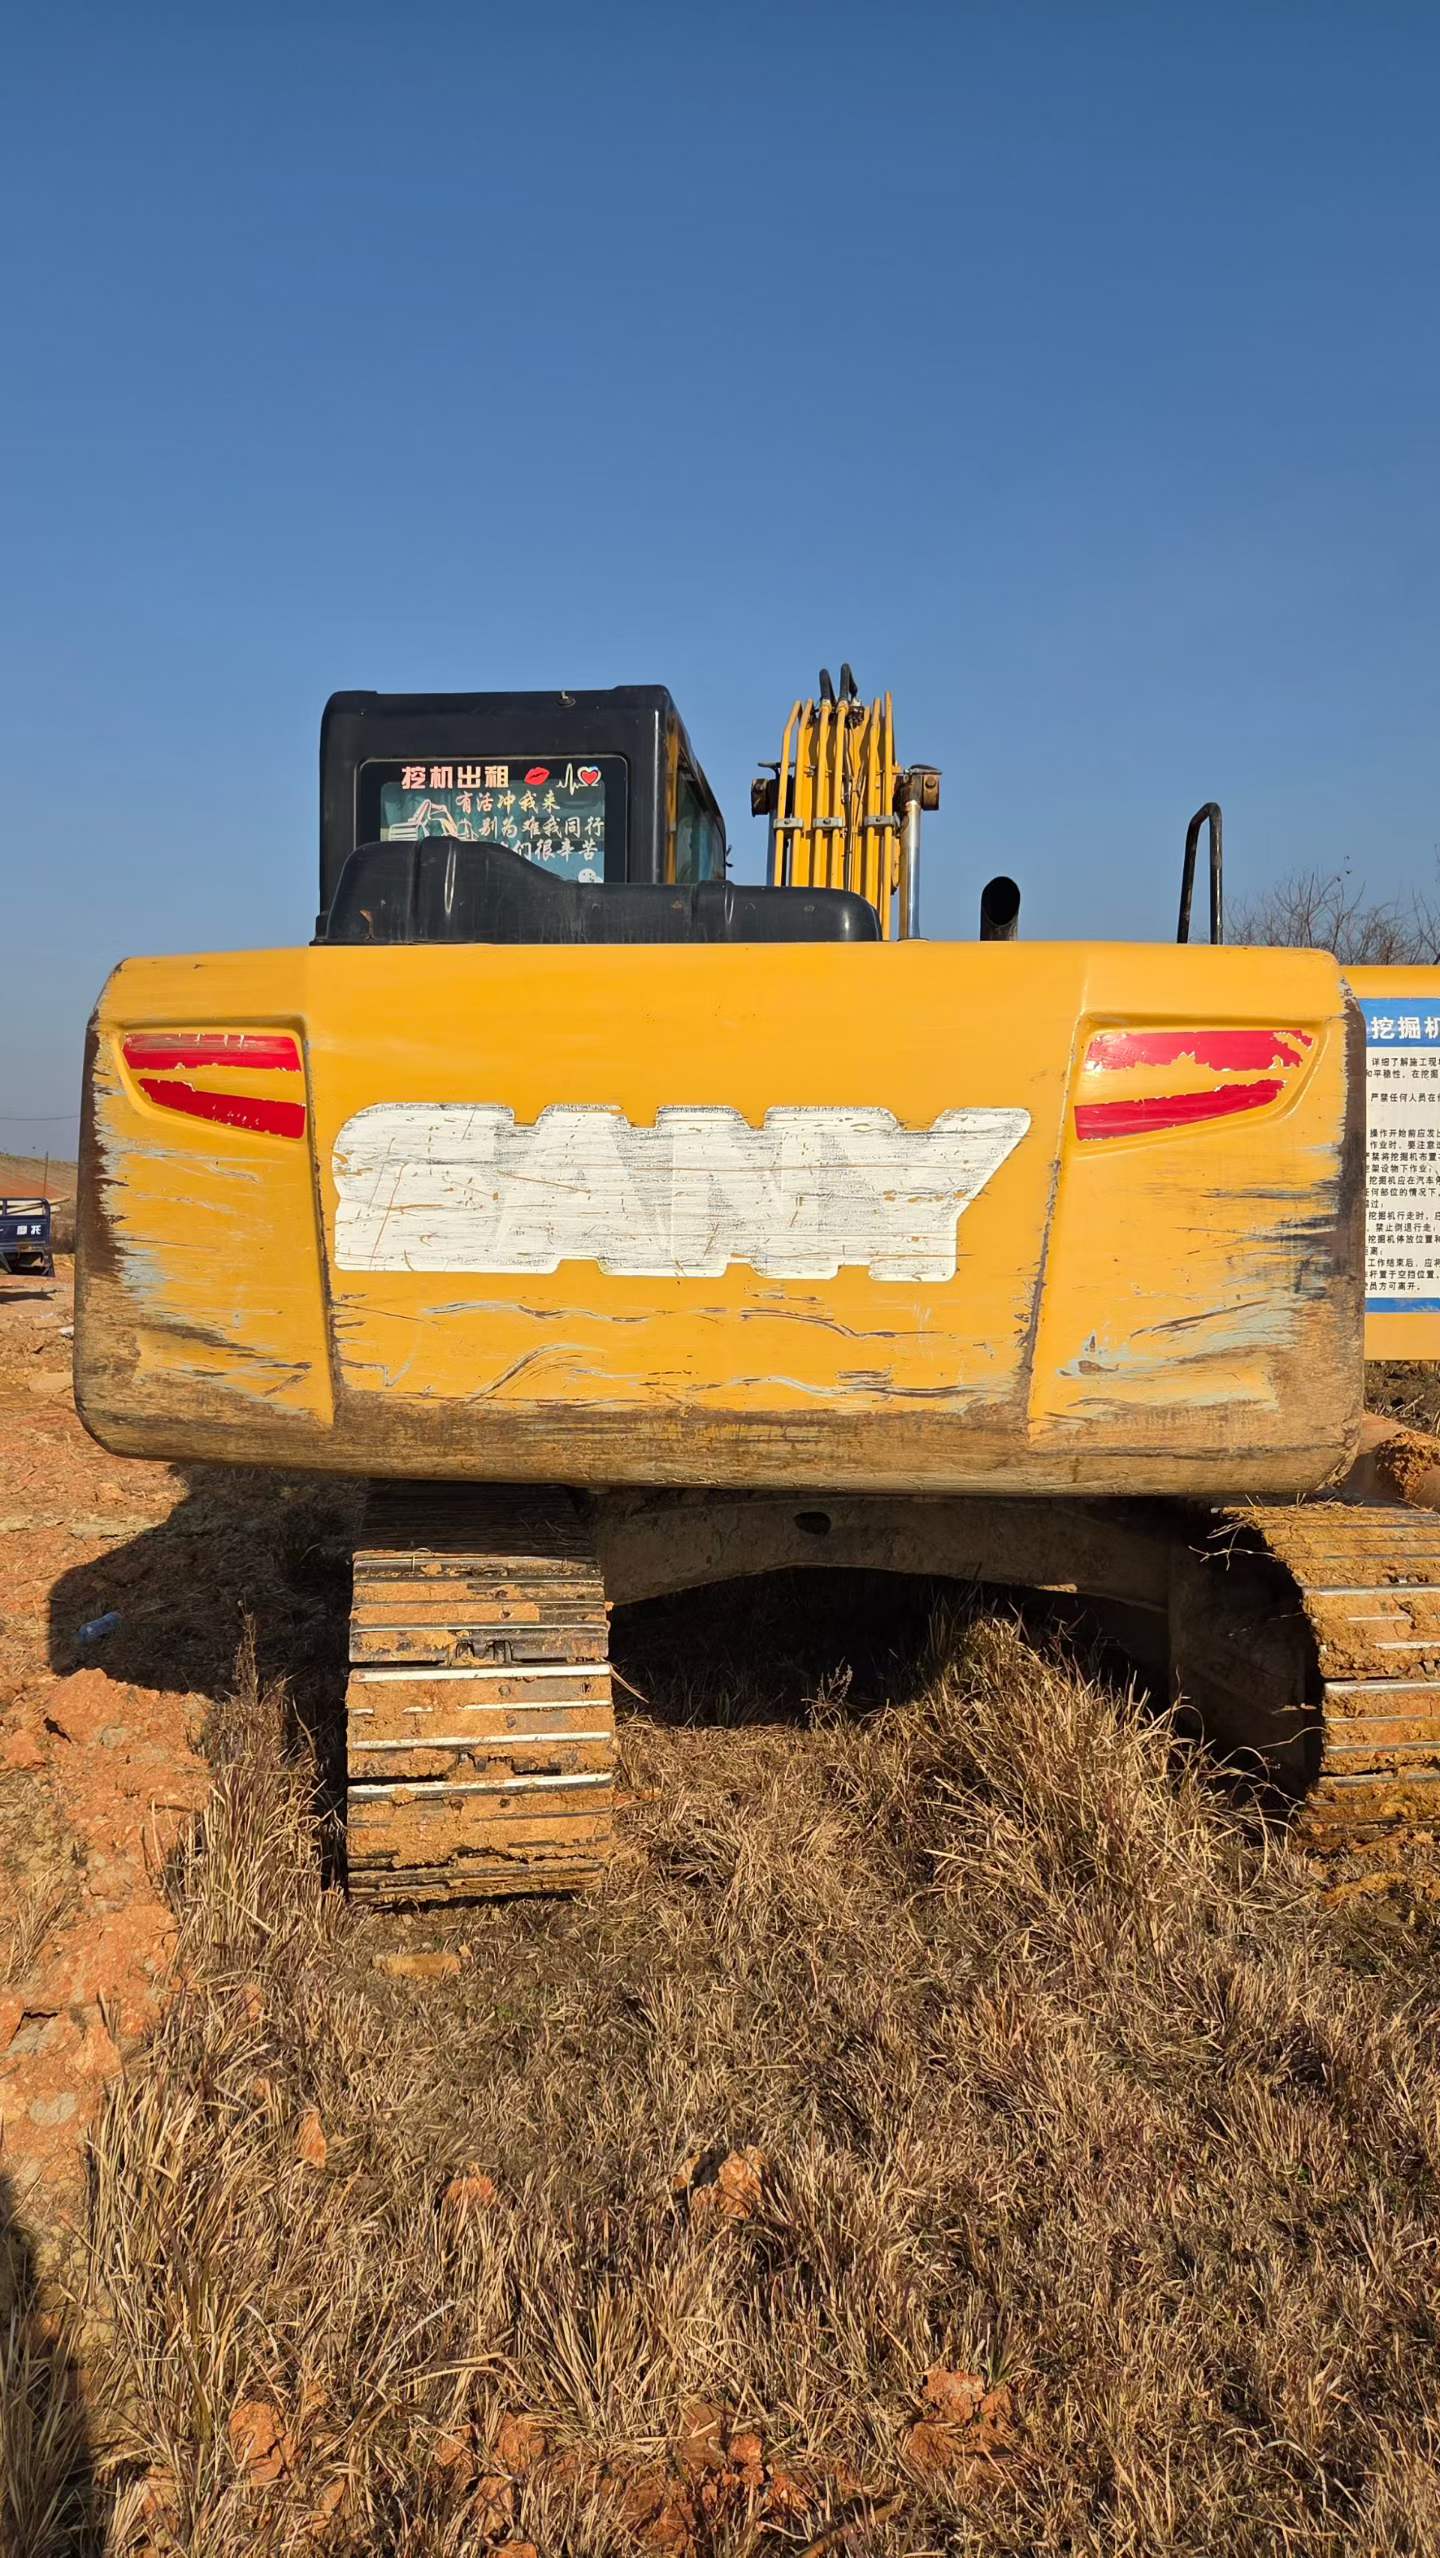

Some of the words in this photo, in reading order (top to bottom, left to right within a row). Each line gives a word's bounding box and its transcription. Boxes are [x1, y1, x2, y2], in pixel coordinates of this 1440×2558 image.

[401, 765, 509, 789] 挖机出租
[456, 790, 560, 814] 有活冲我来
[478, 815, 605, 839] 别为难我同行
